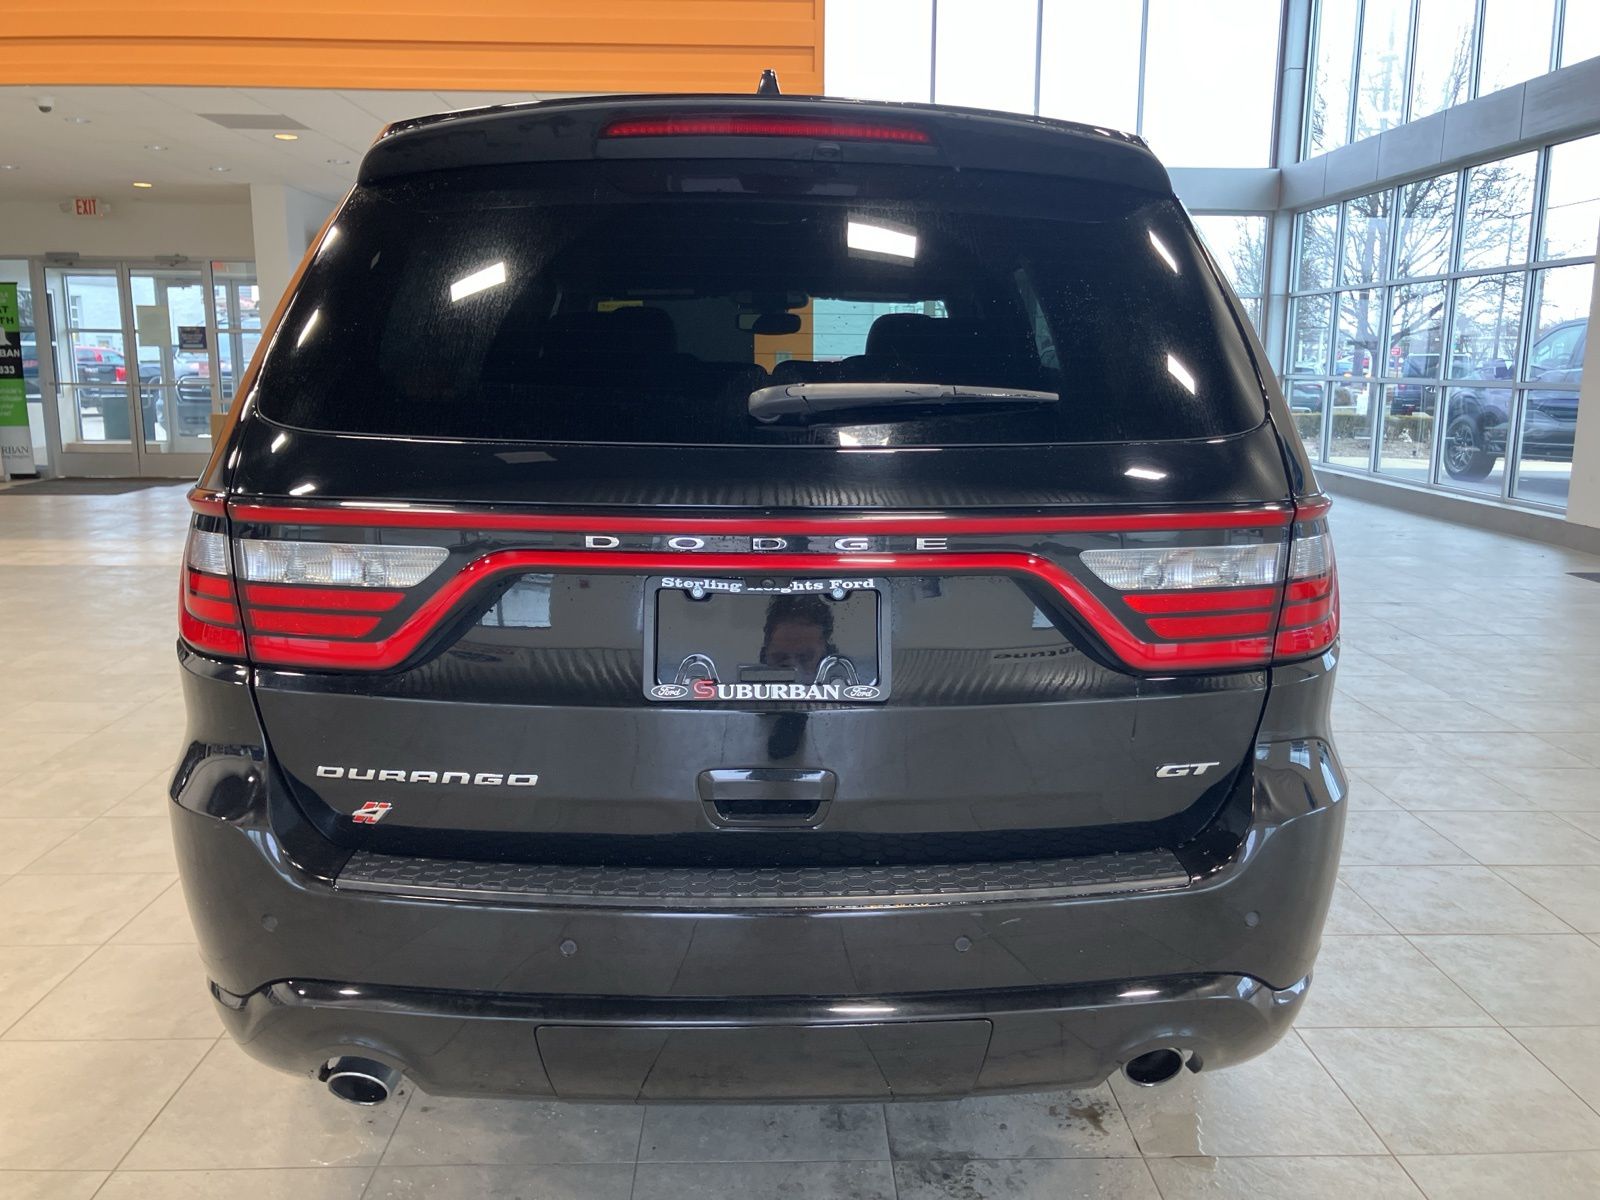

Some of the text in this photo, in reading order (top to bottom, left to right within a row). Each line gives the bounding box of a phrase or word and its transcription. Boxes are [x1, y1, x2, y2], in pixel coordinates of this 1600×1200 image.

[75, 198, 97, 215] EXIT
[584, 534, 949, 551] DODGE
[661, 577, 743, 593] Sterling
[829, 578, 876, 590] Ford
[693, 678, 840, 700] SUBURBAN
[315, 764, 540, 787] DURANGO
[1156, 761, 1220, 778] GT
